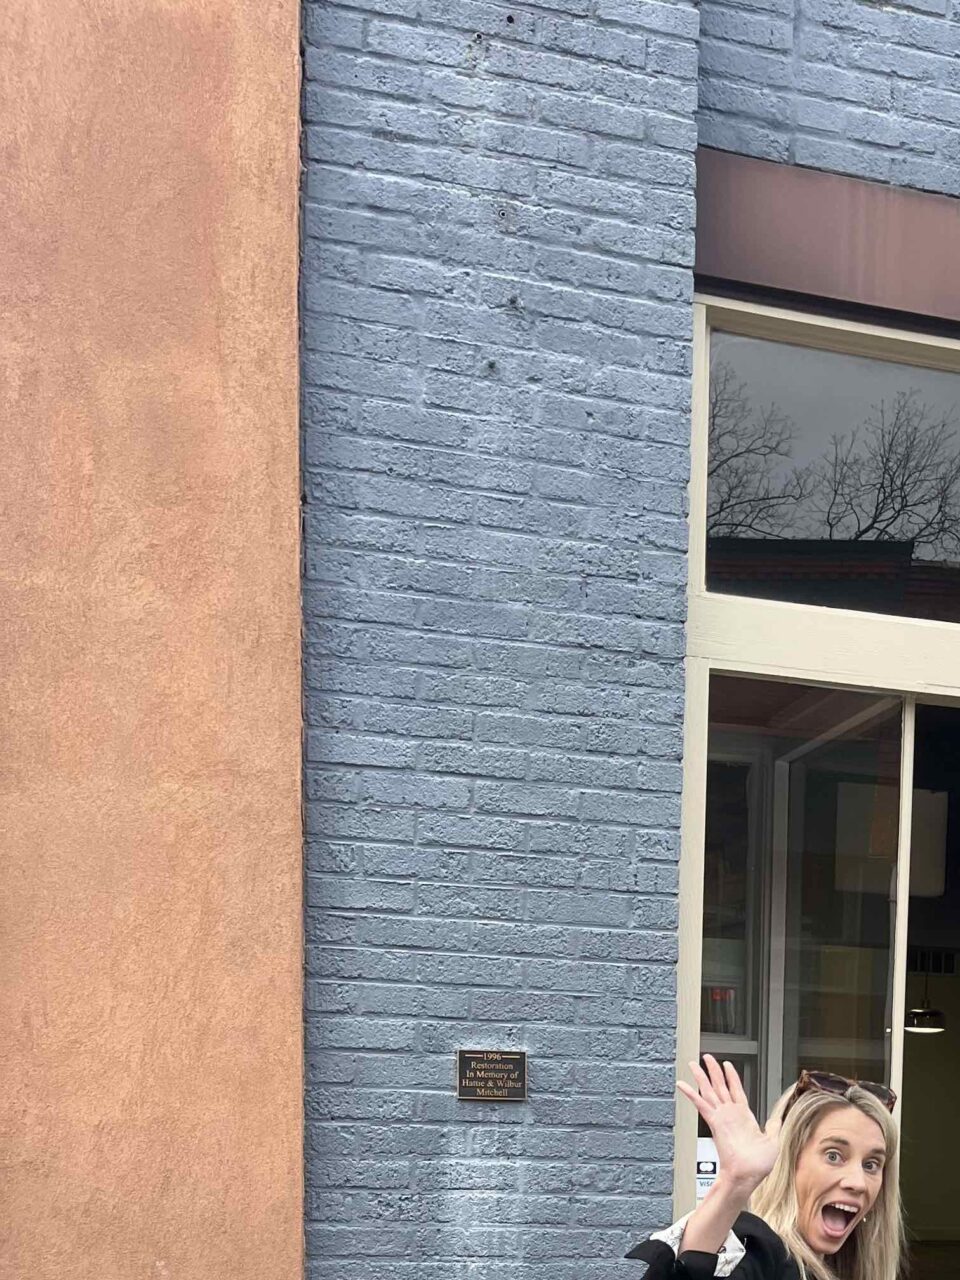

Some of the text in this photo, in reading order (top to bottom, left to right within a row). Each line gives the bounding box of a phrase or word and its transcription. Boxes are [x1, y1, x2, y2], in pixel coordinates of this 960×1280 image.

[484, 1052, 502, 1060] 1996
[471, 1062, 514, 1070] Restoration
[476, 1071, 508, 1080] Memory
